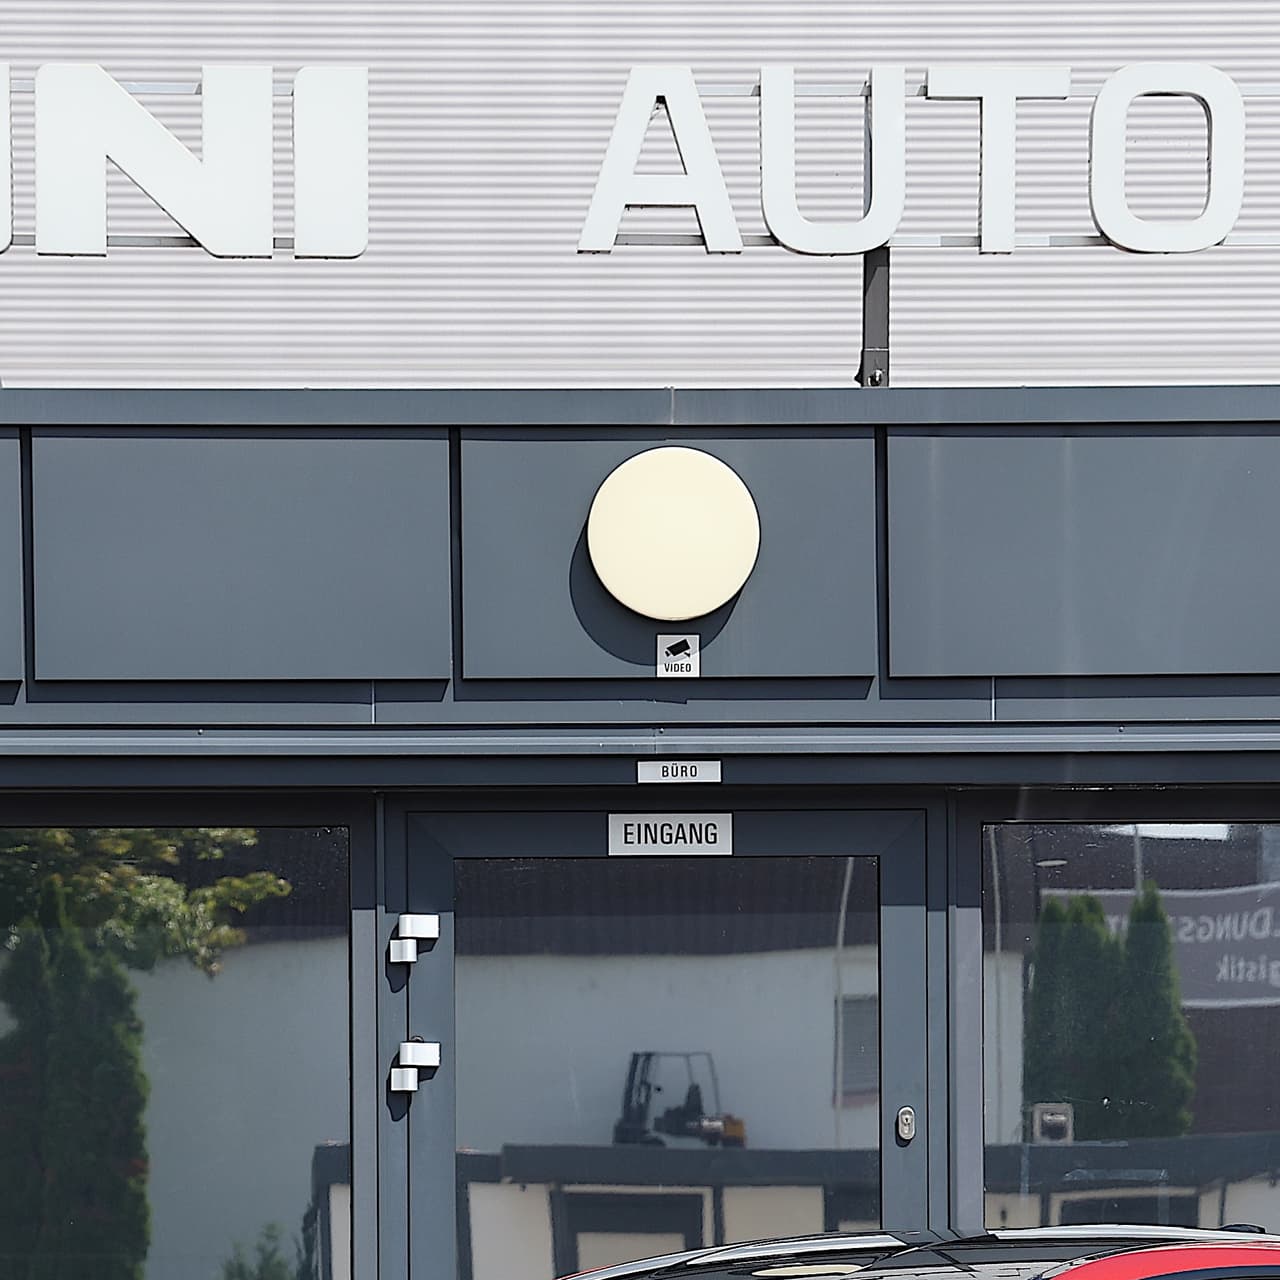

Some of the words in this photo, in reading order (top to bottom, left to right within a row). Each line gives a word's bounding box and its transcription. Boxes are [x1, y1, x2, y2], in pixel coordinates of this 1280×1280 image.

[577, 60, 1246, 256] AUTO
[663, 662, 692, 673] VIDEO
[661, 763, 698, 778] BÜRO
[623, 822, 718, 845] EINGANG
